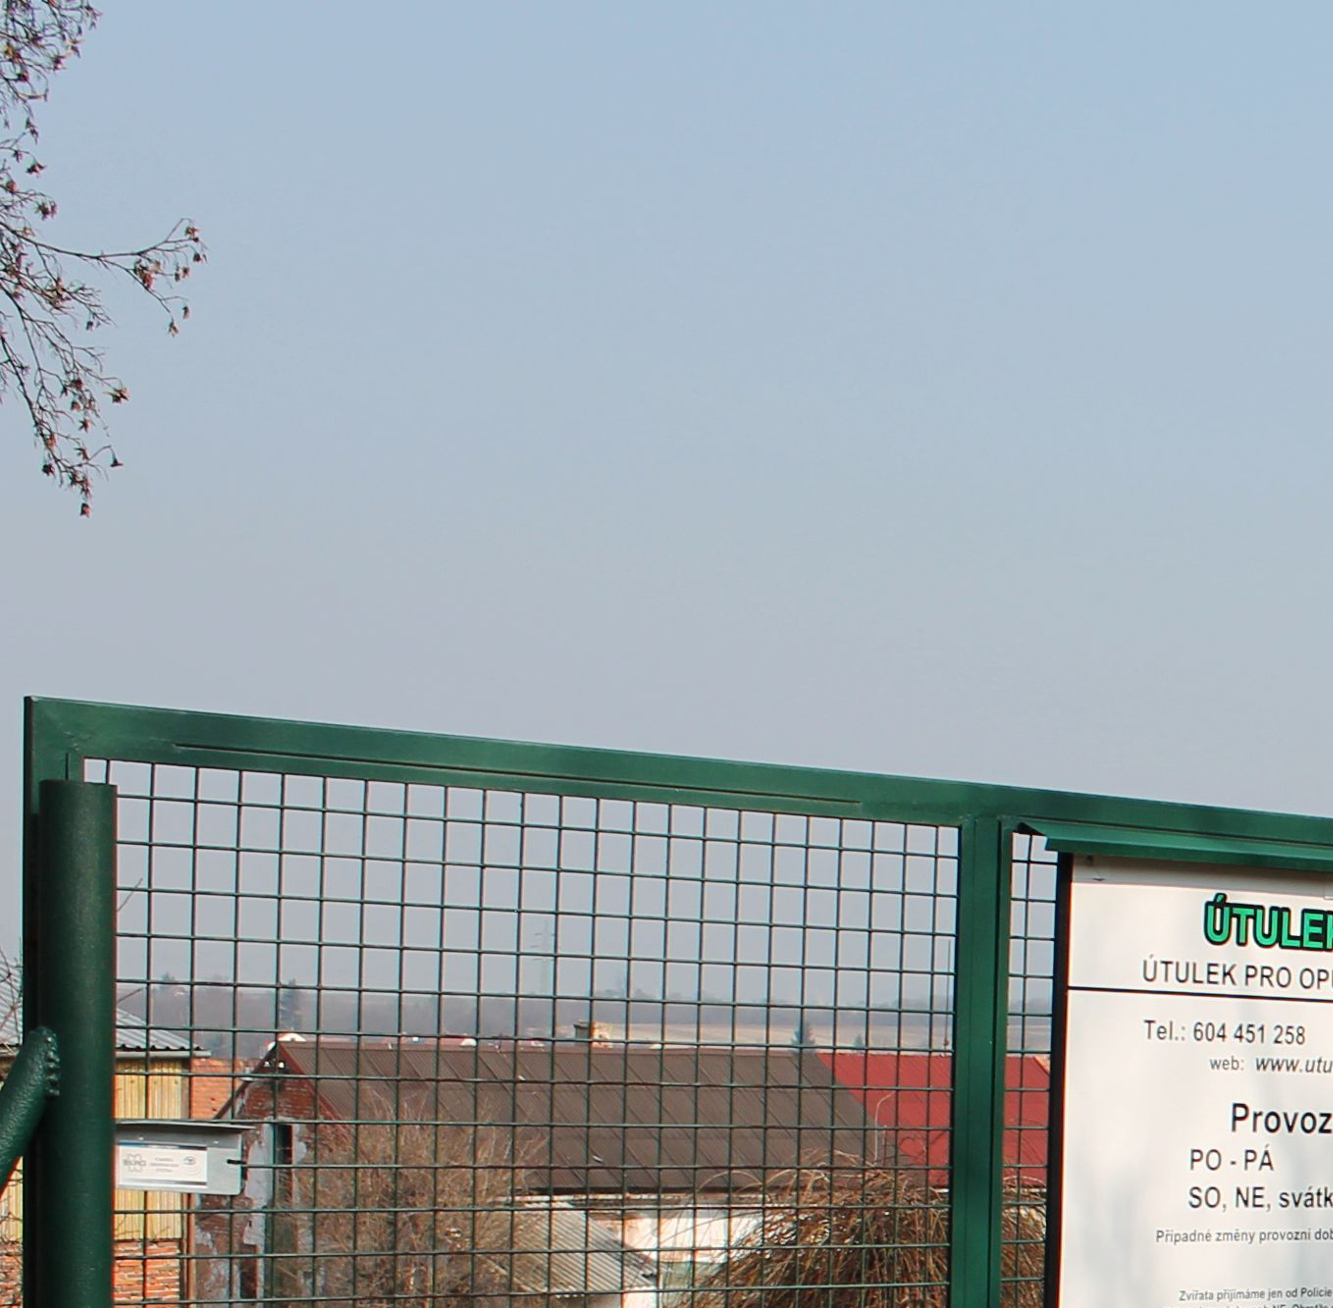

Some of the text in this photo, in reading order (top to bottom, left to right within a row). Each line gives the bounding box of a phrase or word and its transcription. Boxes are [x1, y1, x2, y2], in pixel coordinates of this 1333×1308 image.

[1142, 956, 1236, 987] ÚTULEK
[1244, 965, 1292, 990] PRO
[1144, 1020, 1305, 1045] Tel.: 604 451 258
[1209, 1057, 1244, 1072] web:
[1190, 1149, 1223, 1171] PO
[1244, 1144, 1275, 1172] PÁ
[1189, 1187, 1228, 1211] SO,
[1235, 1187, 1272, 1211] NE,
[1156, 1227, 1212, 1244] Případné
[1215, 1228, 1255, 1244] změny
[1259, 1228, 1311, 1243] provozní
[1267, 1290, 1282, 1300] jen
[1285, 1288, 1297, 1298] od
[1301, 1287, 1332, 1298] Policie
